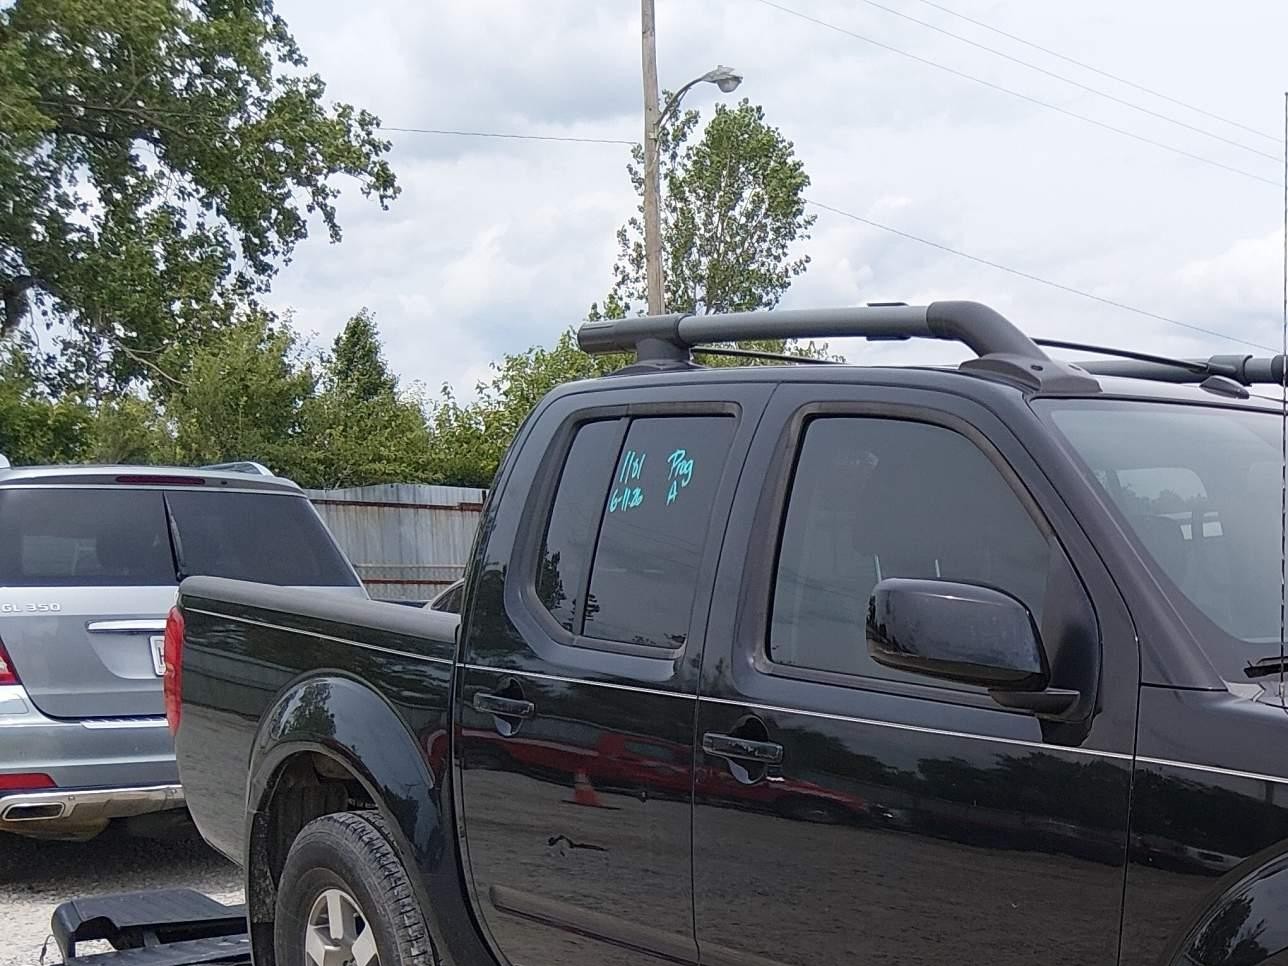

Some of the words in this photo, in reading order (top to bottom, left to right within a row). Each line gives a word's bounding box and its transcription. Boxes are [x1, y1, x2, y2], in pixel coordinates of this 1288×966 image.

[666, 479, 678, 506] A
[2, 603, 21, 612] GL
[23, 602, 61, 612] 350
